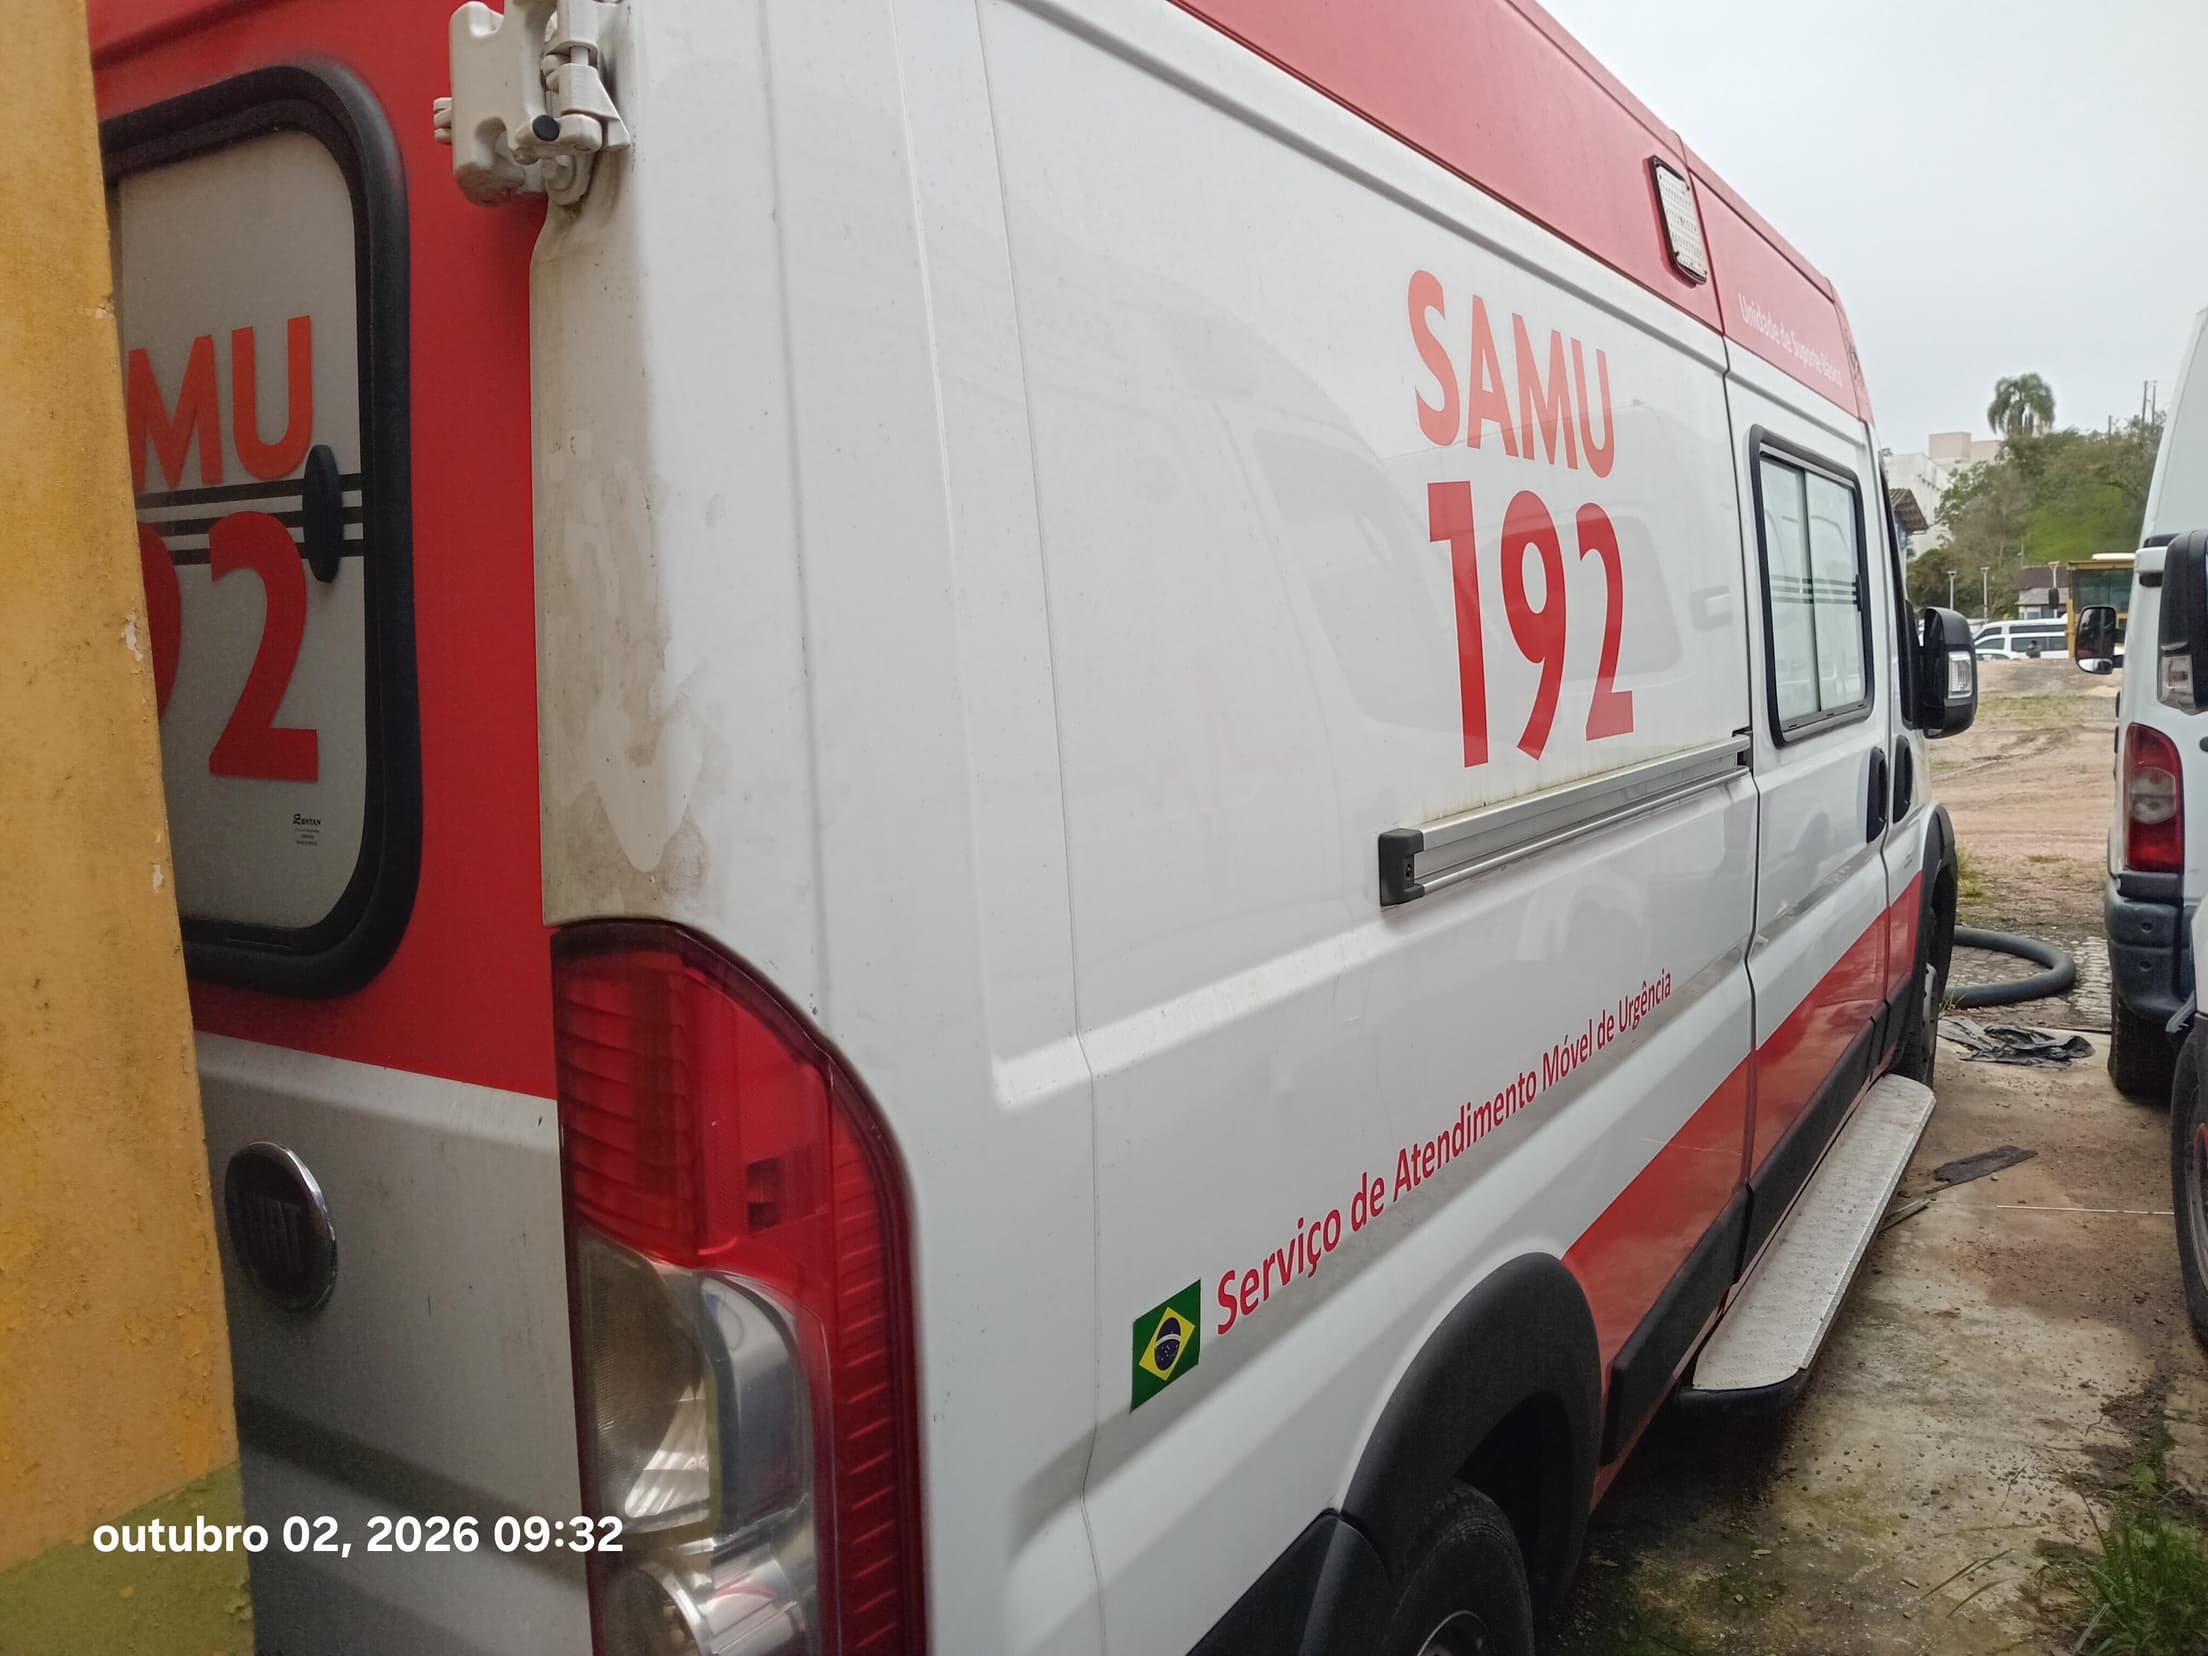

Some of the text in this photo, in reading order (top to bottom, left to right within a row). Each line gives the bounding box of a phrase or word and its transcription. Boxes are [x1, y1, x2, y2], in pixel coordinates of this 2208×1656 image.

[1408, 270, 1615, 478] SAMU
[1426, 480, 1634, 768] 192
[1217, 967, 1671, 1335] Serviço de Atendimento Móvel de Urgência
